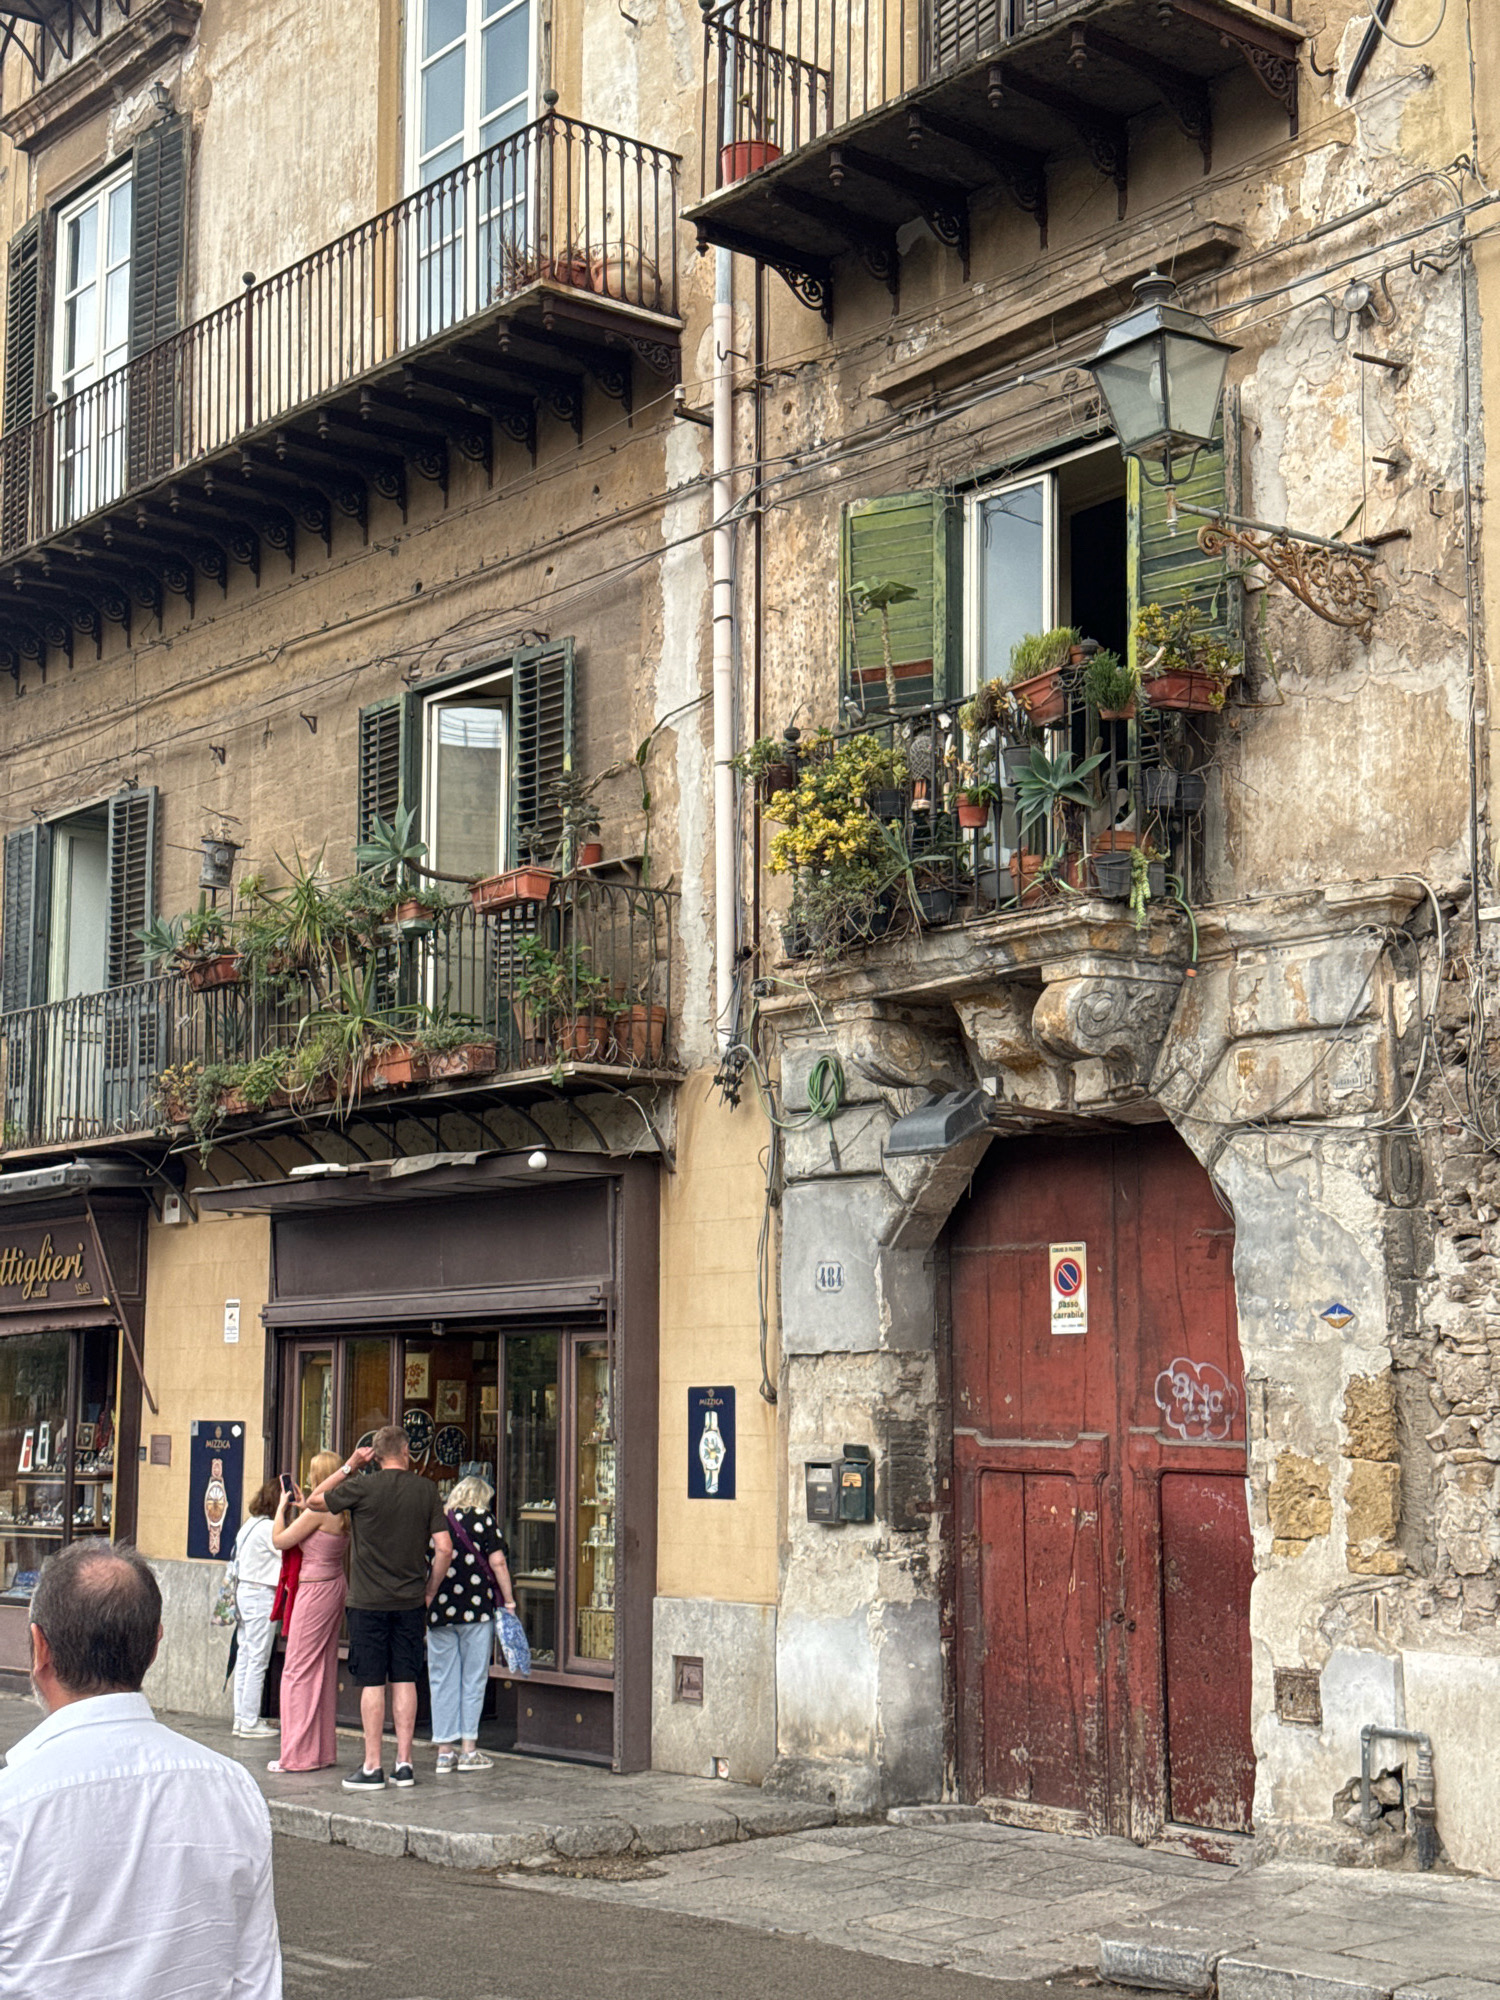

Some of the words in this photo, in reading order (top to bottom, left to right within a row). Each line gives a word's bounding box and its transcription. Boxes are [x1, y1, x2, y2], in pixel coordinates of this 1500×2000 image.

[818, 1266, 843, 1288] 484
[1058, 1300, 1079, 1309] passo
[1053, 1311, 1084, 1319] carrabile
[698, 1398, 724, 1406] MIZZICA
[205, 1439, 231, 1449] MIZZICA
